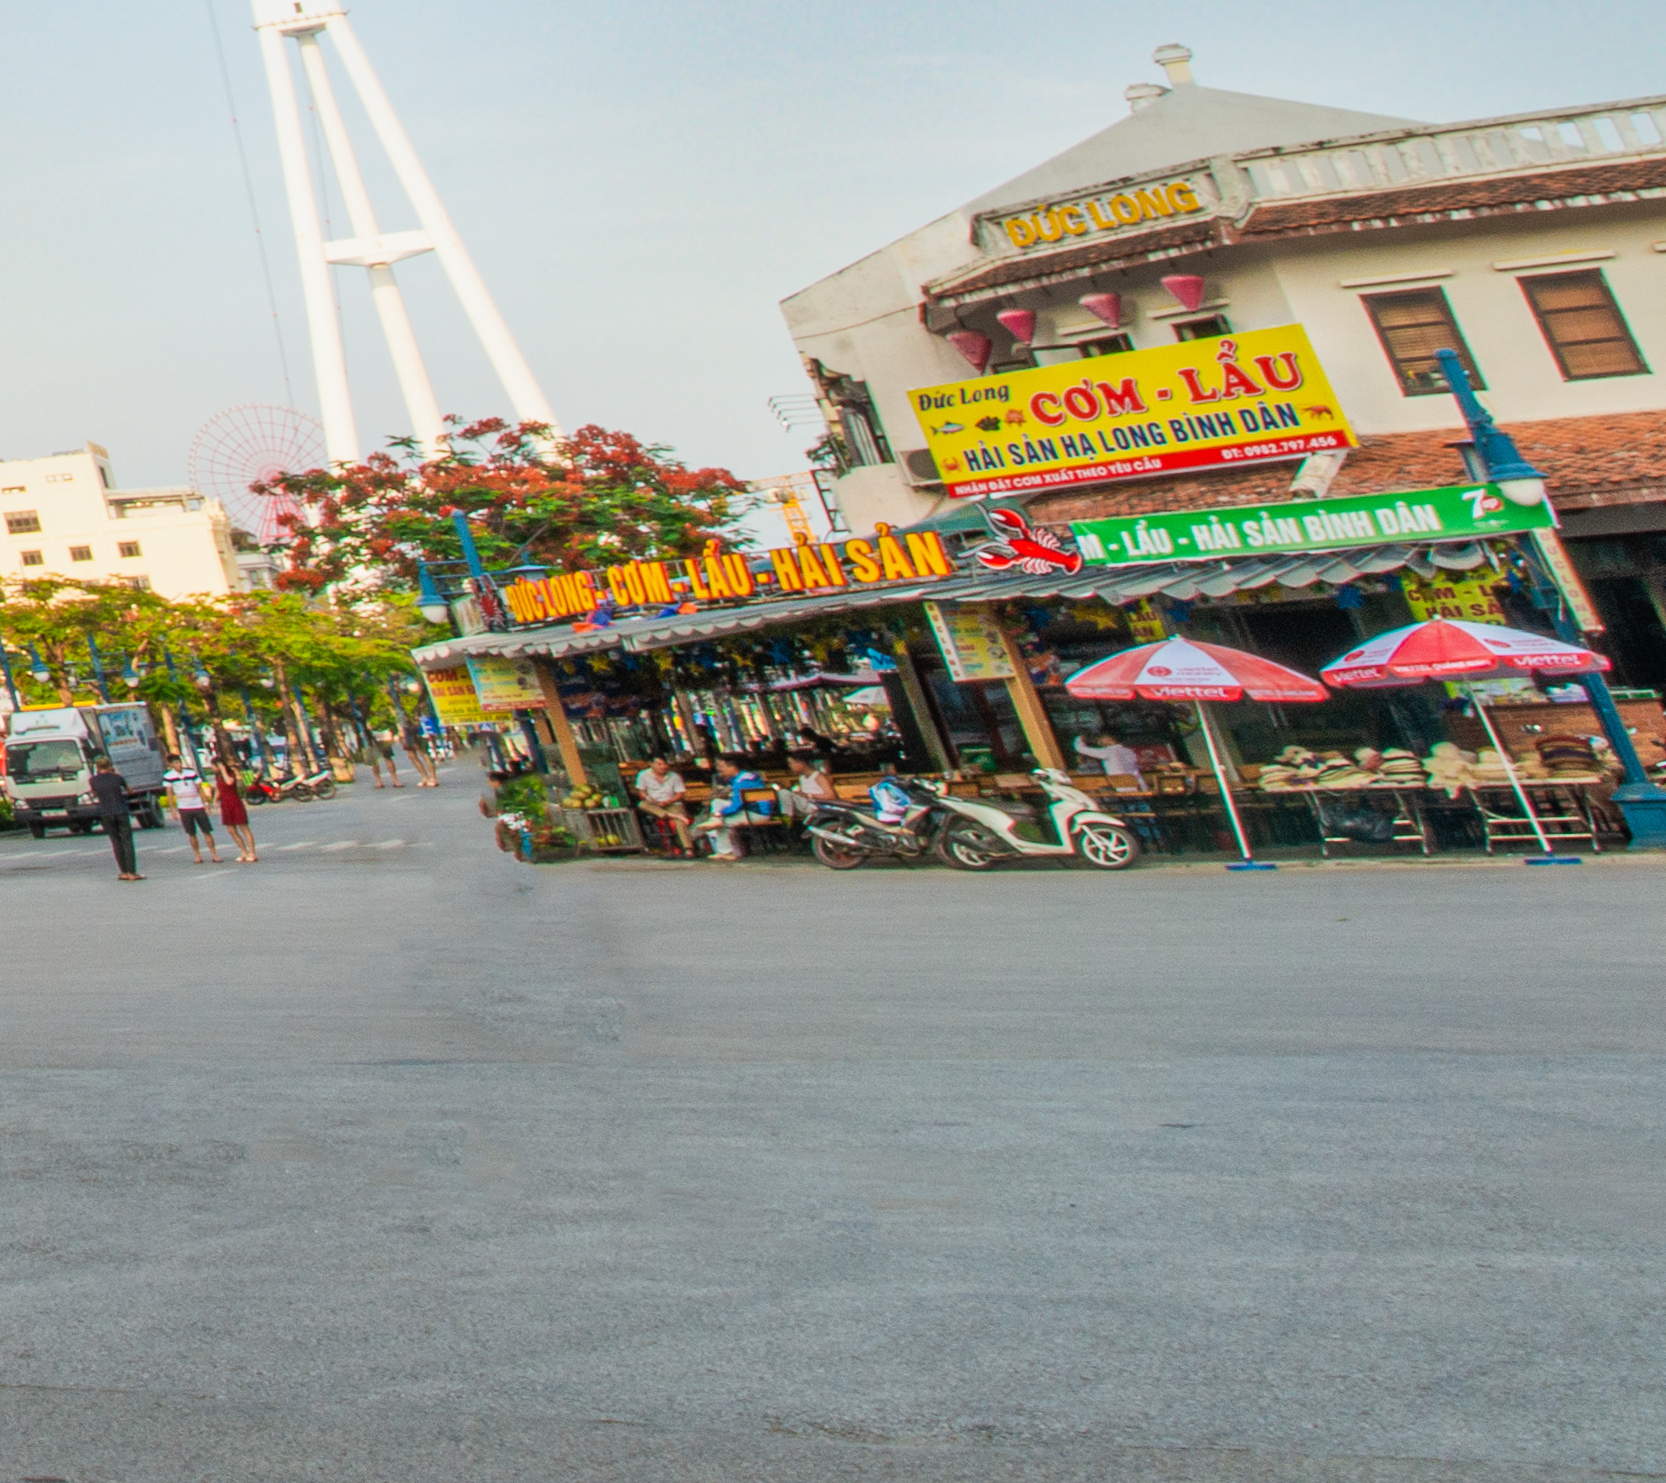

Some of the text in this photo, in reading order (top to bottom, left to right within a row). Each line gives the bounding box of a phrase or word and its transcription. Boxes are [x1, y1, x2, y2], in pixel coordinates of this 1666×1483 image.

[1005, 182, 1200, 248] ĐỨC LONG
[918, 384, 1011, 412] Đức Long
[1029, 377, 1149, 427] CƠM
[1176, 339, 1304, 405] LẨU
[963, 400, 1302, 472] HẢI SẢN HẠ LONG BÌNH DÂN
[1076, 466, 1108, 479] THEO
[1191, 515, 1242, 551] HẢI
[1242, 511, 1304, 547] SẢN
[1302, 509, 1376, 543] BÌNH
[1375, 501, 1443, 536] DÂN
[544, 570, 598, 618] LONG
[607, 559, 675, 608] CƠM
[770, 531, 848, 592] HẢI
[845, 521, 953, 584] SẢN
[1407, 585, 1456, 603] CM
[1513, 654, 1581, 667] viettel
[1152, 685, 1228, 698] viettel
